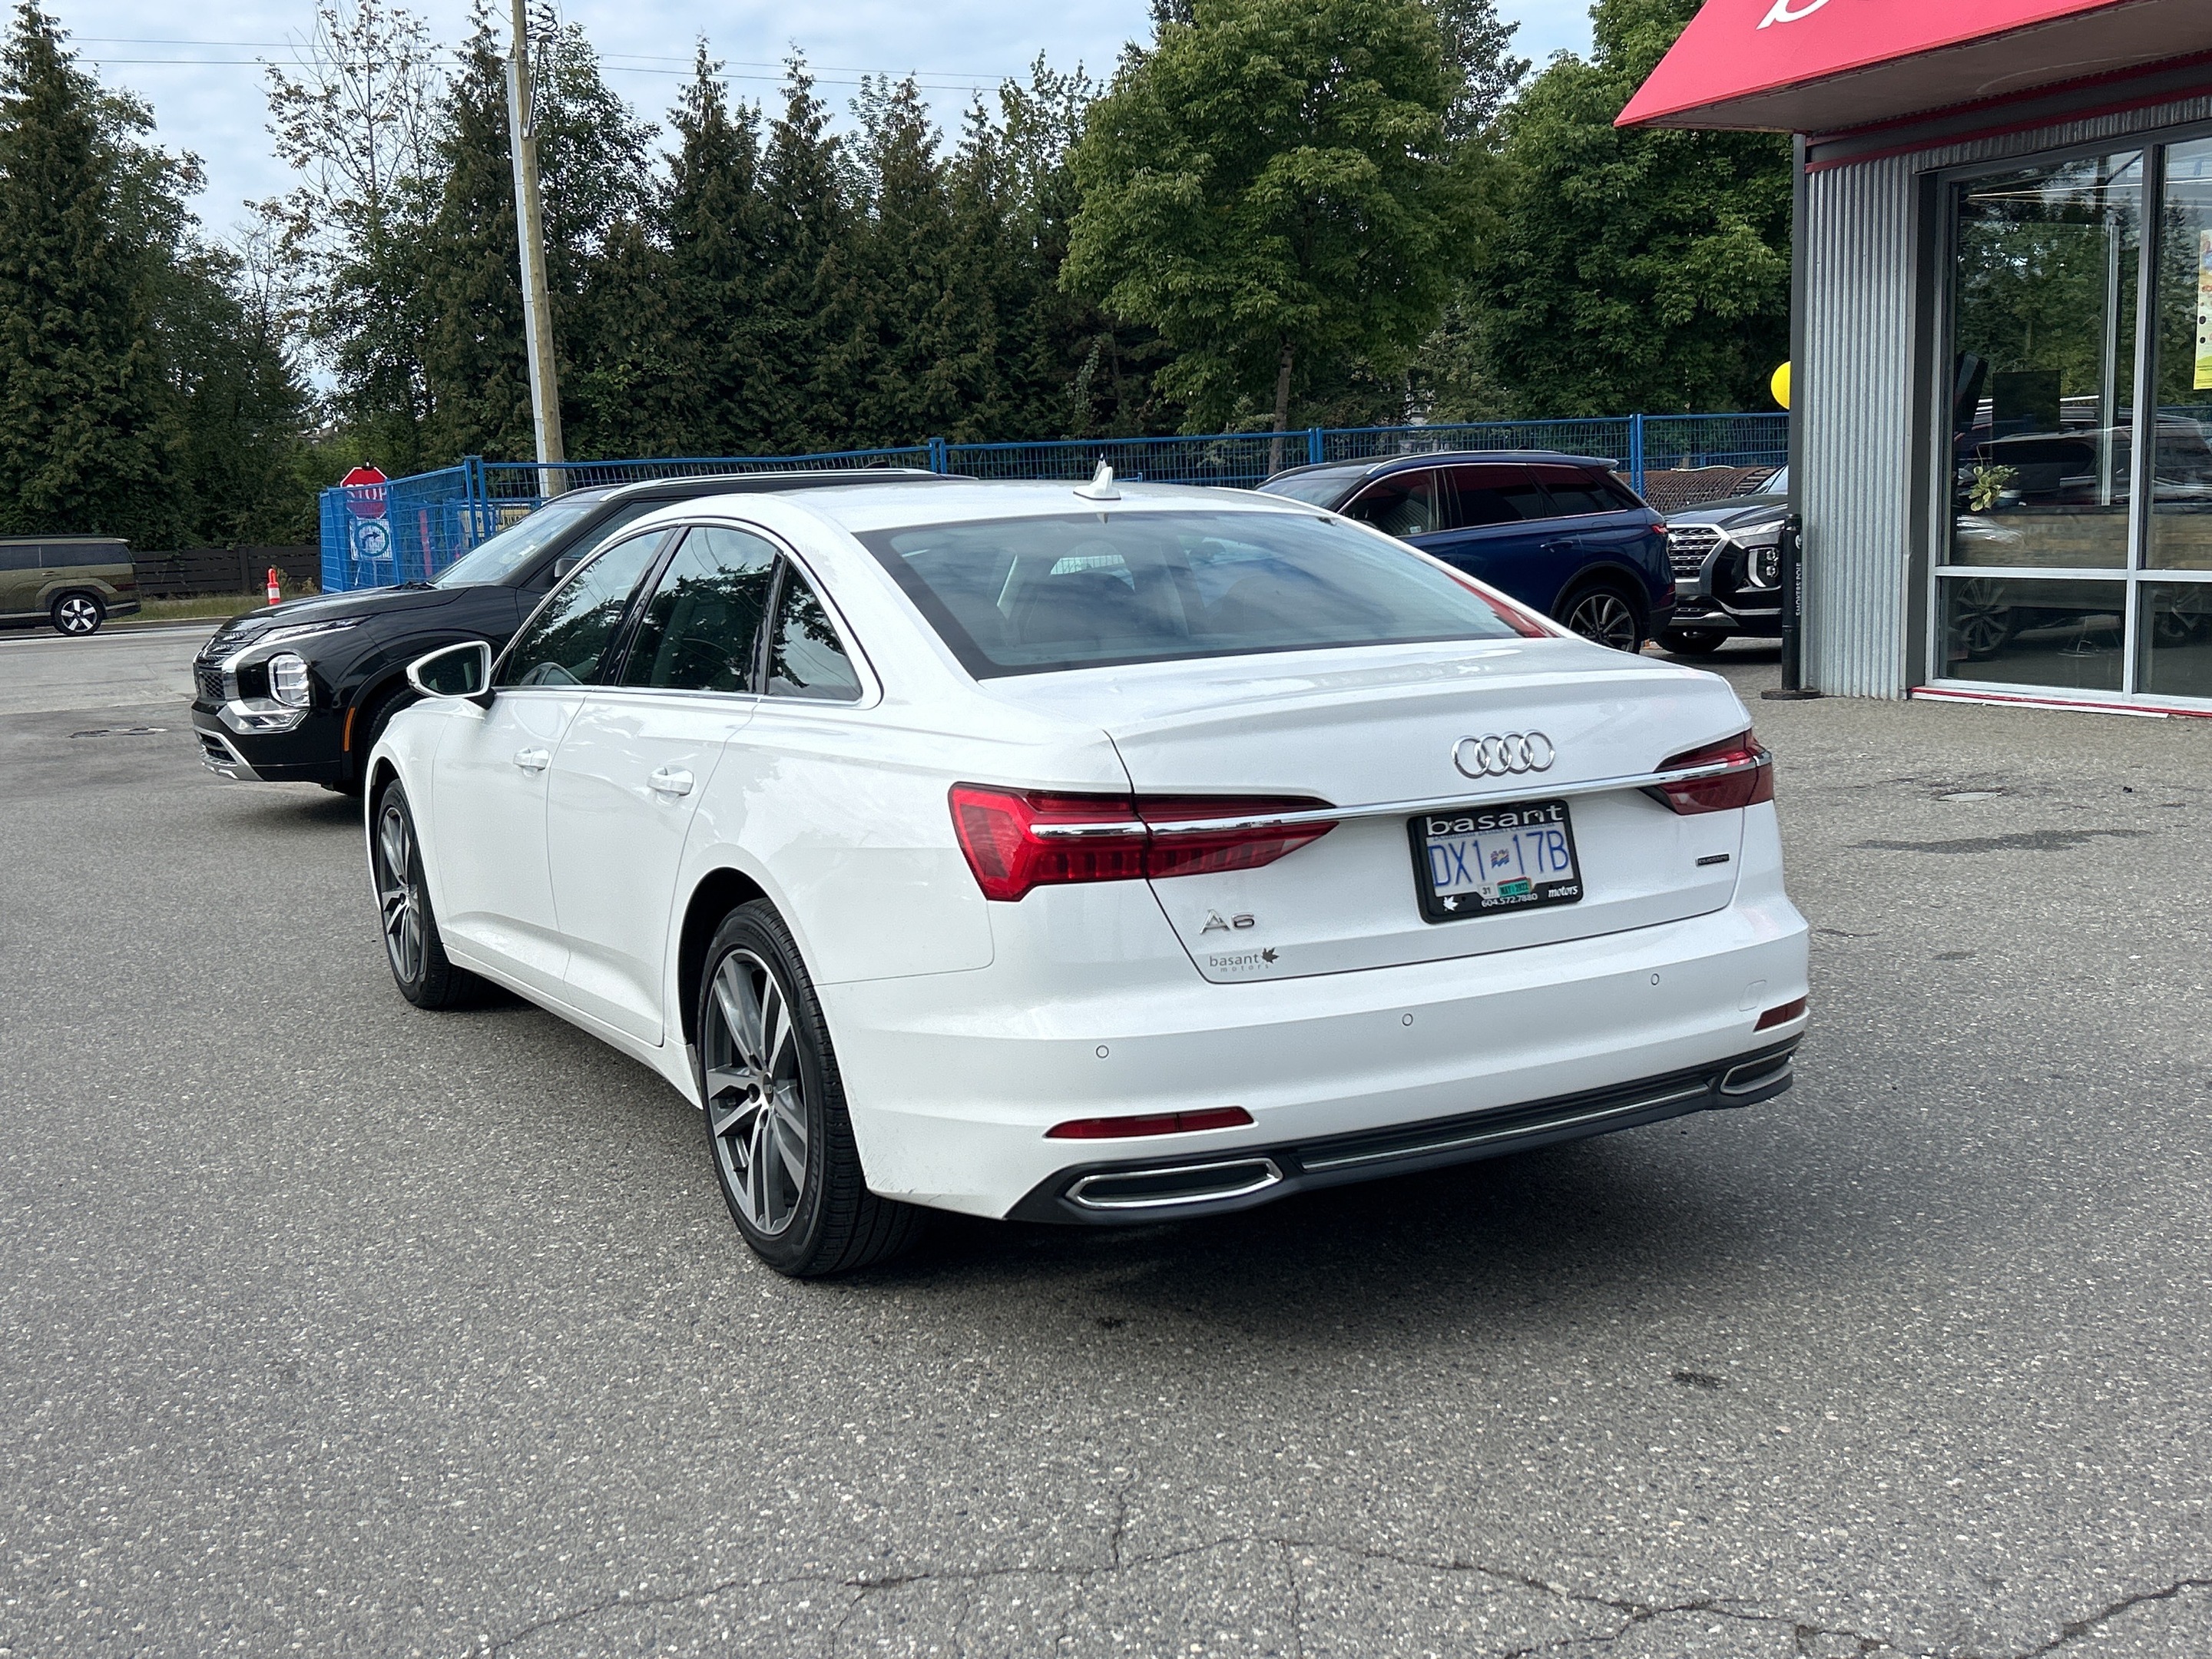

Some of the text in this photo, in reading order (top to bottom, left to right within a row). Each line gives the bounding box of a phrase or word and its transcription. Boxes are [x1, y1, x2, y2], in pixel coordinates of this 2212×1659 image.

[346, 484, 388, 502] STOP
[1426, 805, 1564, 836] basant
[1429, 839, 1485, 887] DX1
[1512, 830, 1569, 875] 17B
[1482, 886, 1491, 895] 31
[1548, 886, 1578, 898] motors
[1199, 909, 1255, 935] A6
[1209, 953, 1259, 967] basant
[1220, 964, 1269, 972] motors
